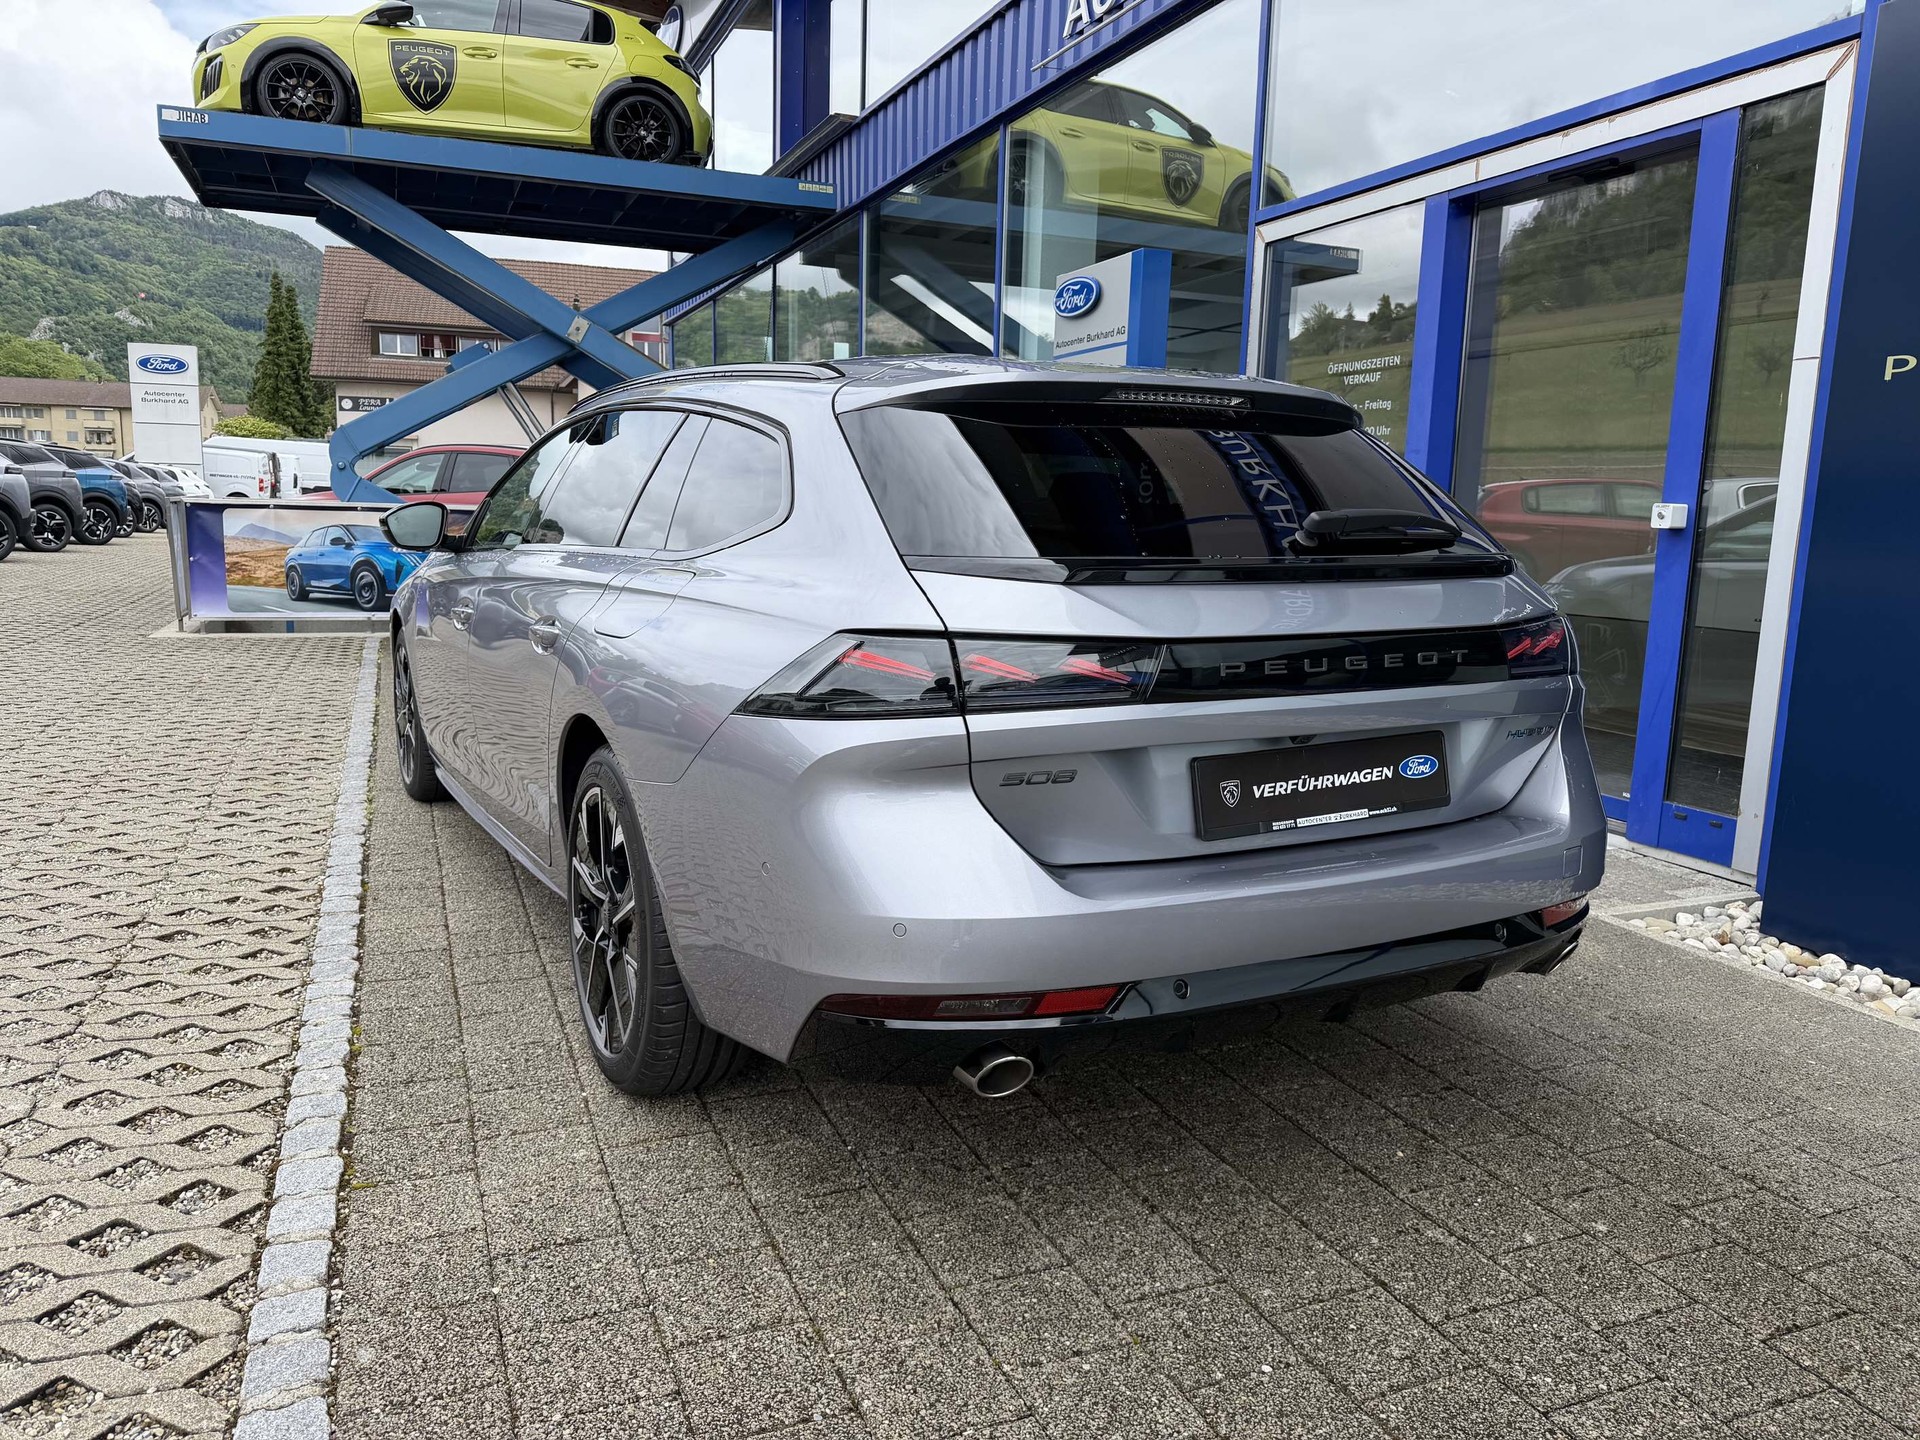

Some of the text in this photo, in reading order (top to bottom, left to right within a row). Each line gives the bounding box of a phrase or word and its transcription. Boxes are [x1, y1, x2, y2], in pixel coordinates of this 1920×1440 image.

[395, 45, 451, 56] PEUGEOT
[176, 110, 206, 123] JIHAB
[1056, 284, 1088, 310] Ford
[1055, 325, 1126, 350] Autocenter Burkhard AG
[147, 357, 179, 371] Ford
[1327, 355, 1401, 375] ÖFFNUNGSZEITEN
[1343, 371, 1382, 385] VERKAUF
[141, 396, 176, 404] Burkhard
[358, 398, 381, 406] PERA
[1364, 399, 1392, 411] Freitag
[1376, 425, 1391, 436] Uhr
[1219, 649, 1469, 677] PEUGEOT
[1406, 758, 1431, 775] Ford
[999, 769, 1079, 787] 508
[1252, 765, 1394, 799] VERFÜHRWAGEN
[1298, 815, 1333, 825] AUTOCENTER
